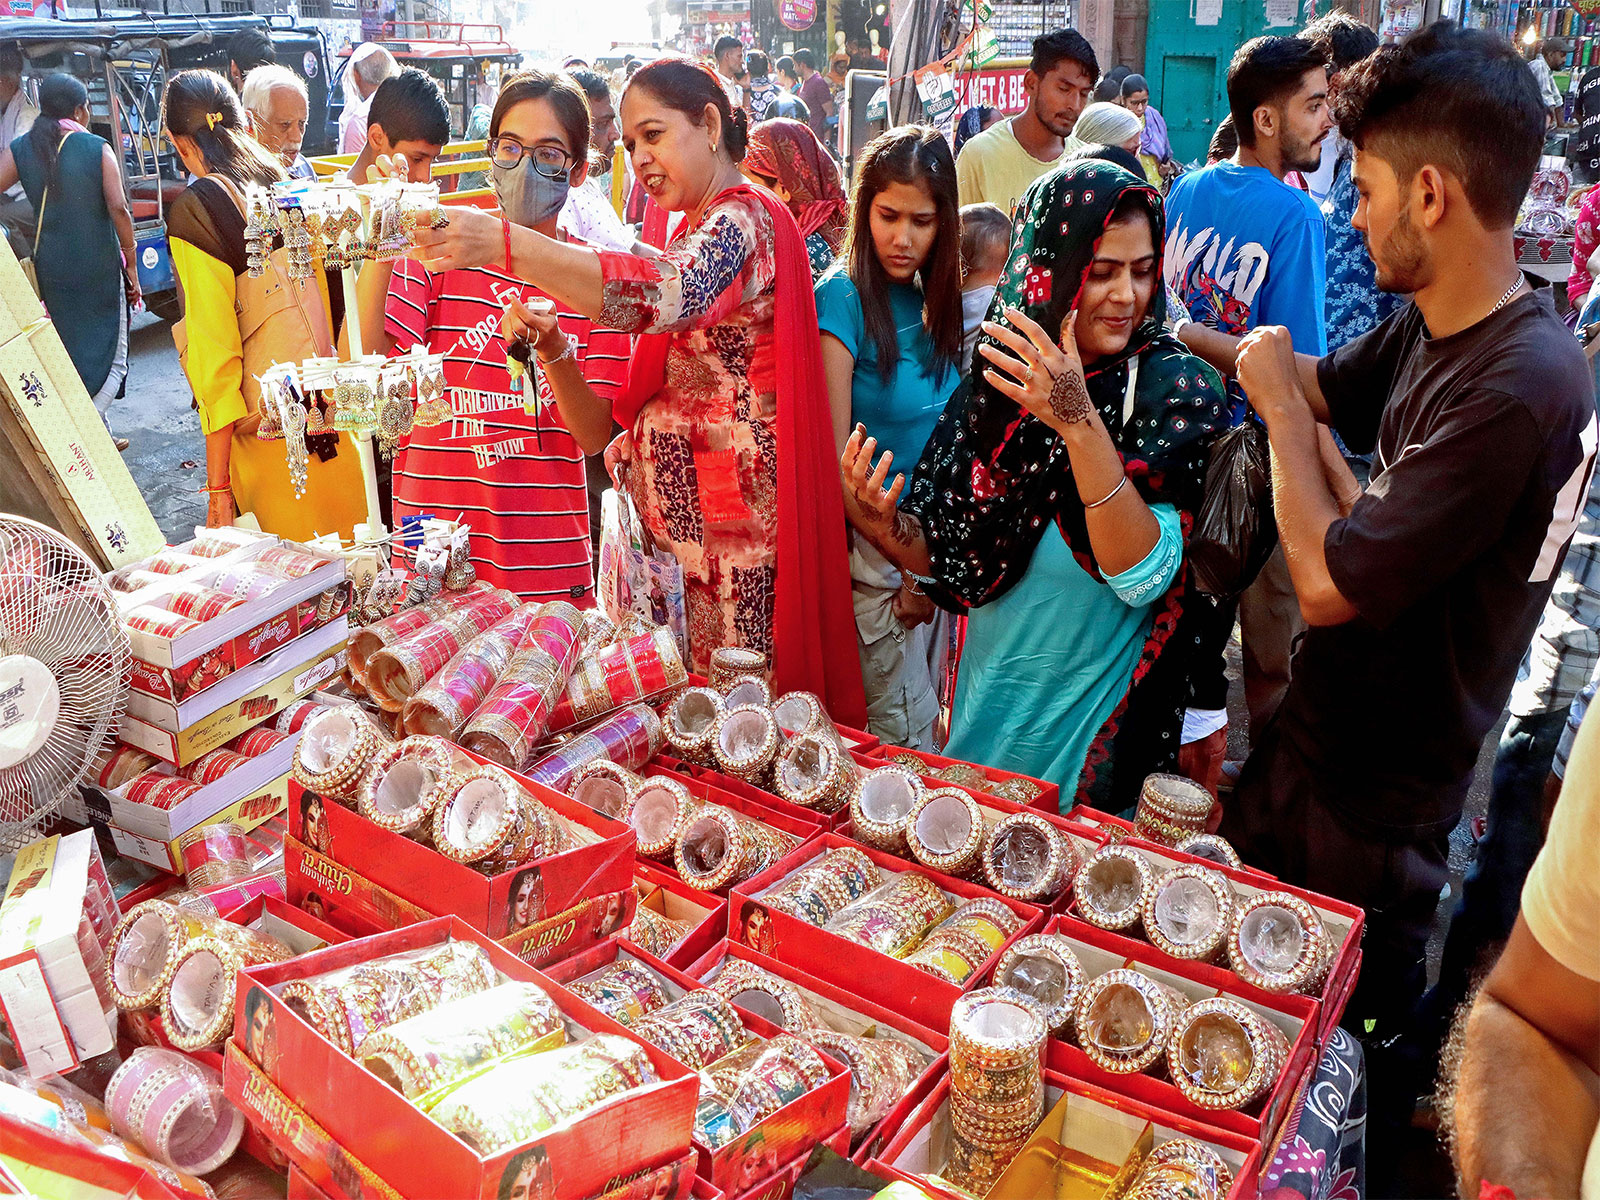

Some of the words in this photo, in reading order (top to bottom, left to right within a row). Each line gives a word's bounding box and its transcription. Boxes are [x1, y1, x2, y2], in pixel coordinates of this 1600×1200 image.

[953, 76, 996, 115] ELMET
[998, 75, 1007, 110] &
[1009, 75, 1031, 108] BE
[471, 438, 525, 469] DENIM
[248, 620, 292, 655] Bangles
[299, 664, 331, 690] Bangles
[85, 806, 111, 821] ANGLES
[299, 858, 337, 894] Suhaag
[303, 851, 353, 896] Chura
[520, 918, 577, 955] Chura
[248, 1070, 304, 1145] Chura
